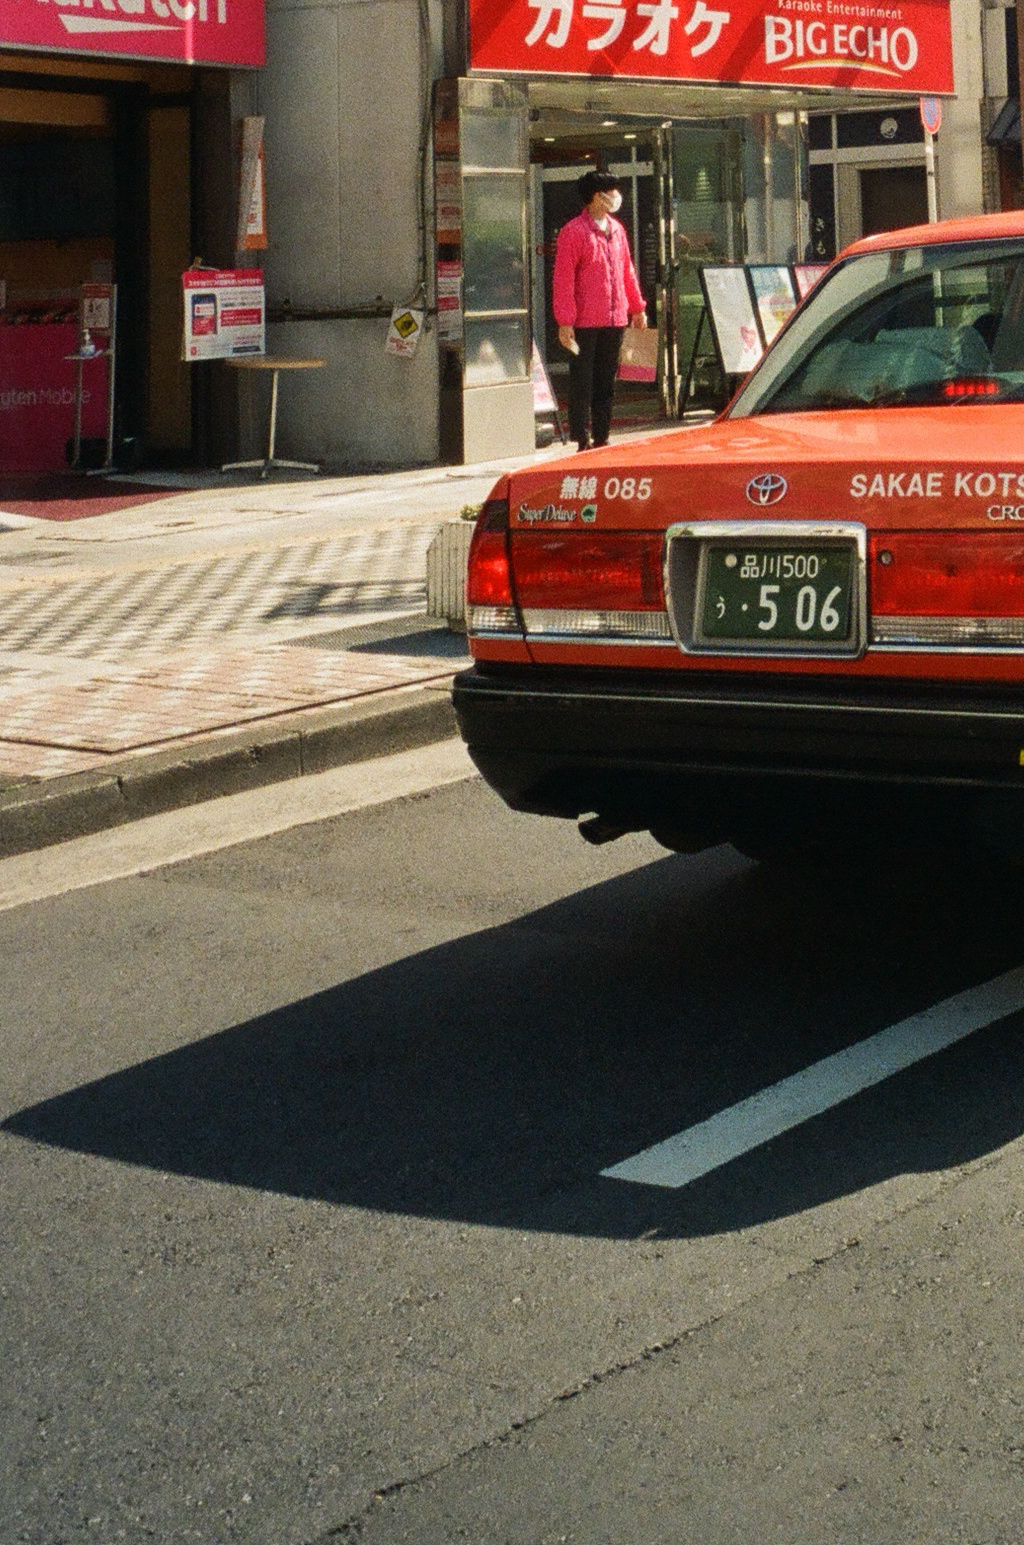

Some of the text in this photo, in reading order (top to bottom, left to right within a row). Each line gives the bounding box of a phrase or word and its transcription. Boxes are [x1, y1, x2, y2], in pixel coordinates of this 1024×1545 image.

[826, 0, 903, 20] Entertainment
[765, 14, 919, 71] BIG ECHO
[603, 476, 653, 501] 085
[850, 472, 944, 497] SAKAE
[740, 554, 819, 579] 品川500
[716, 596, 726, 619] う
